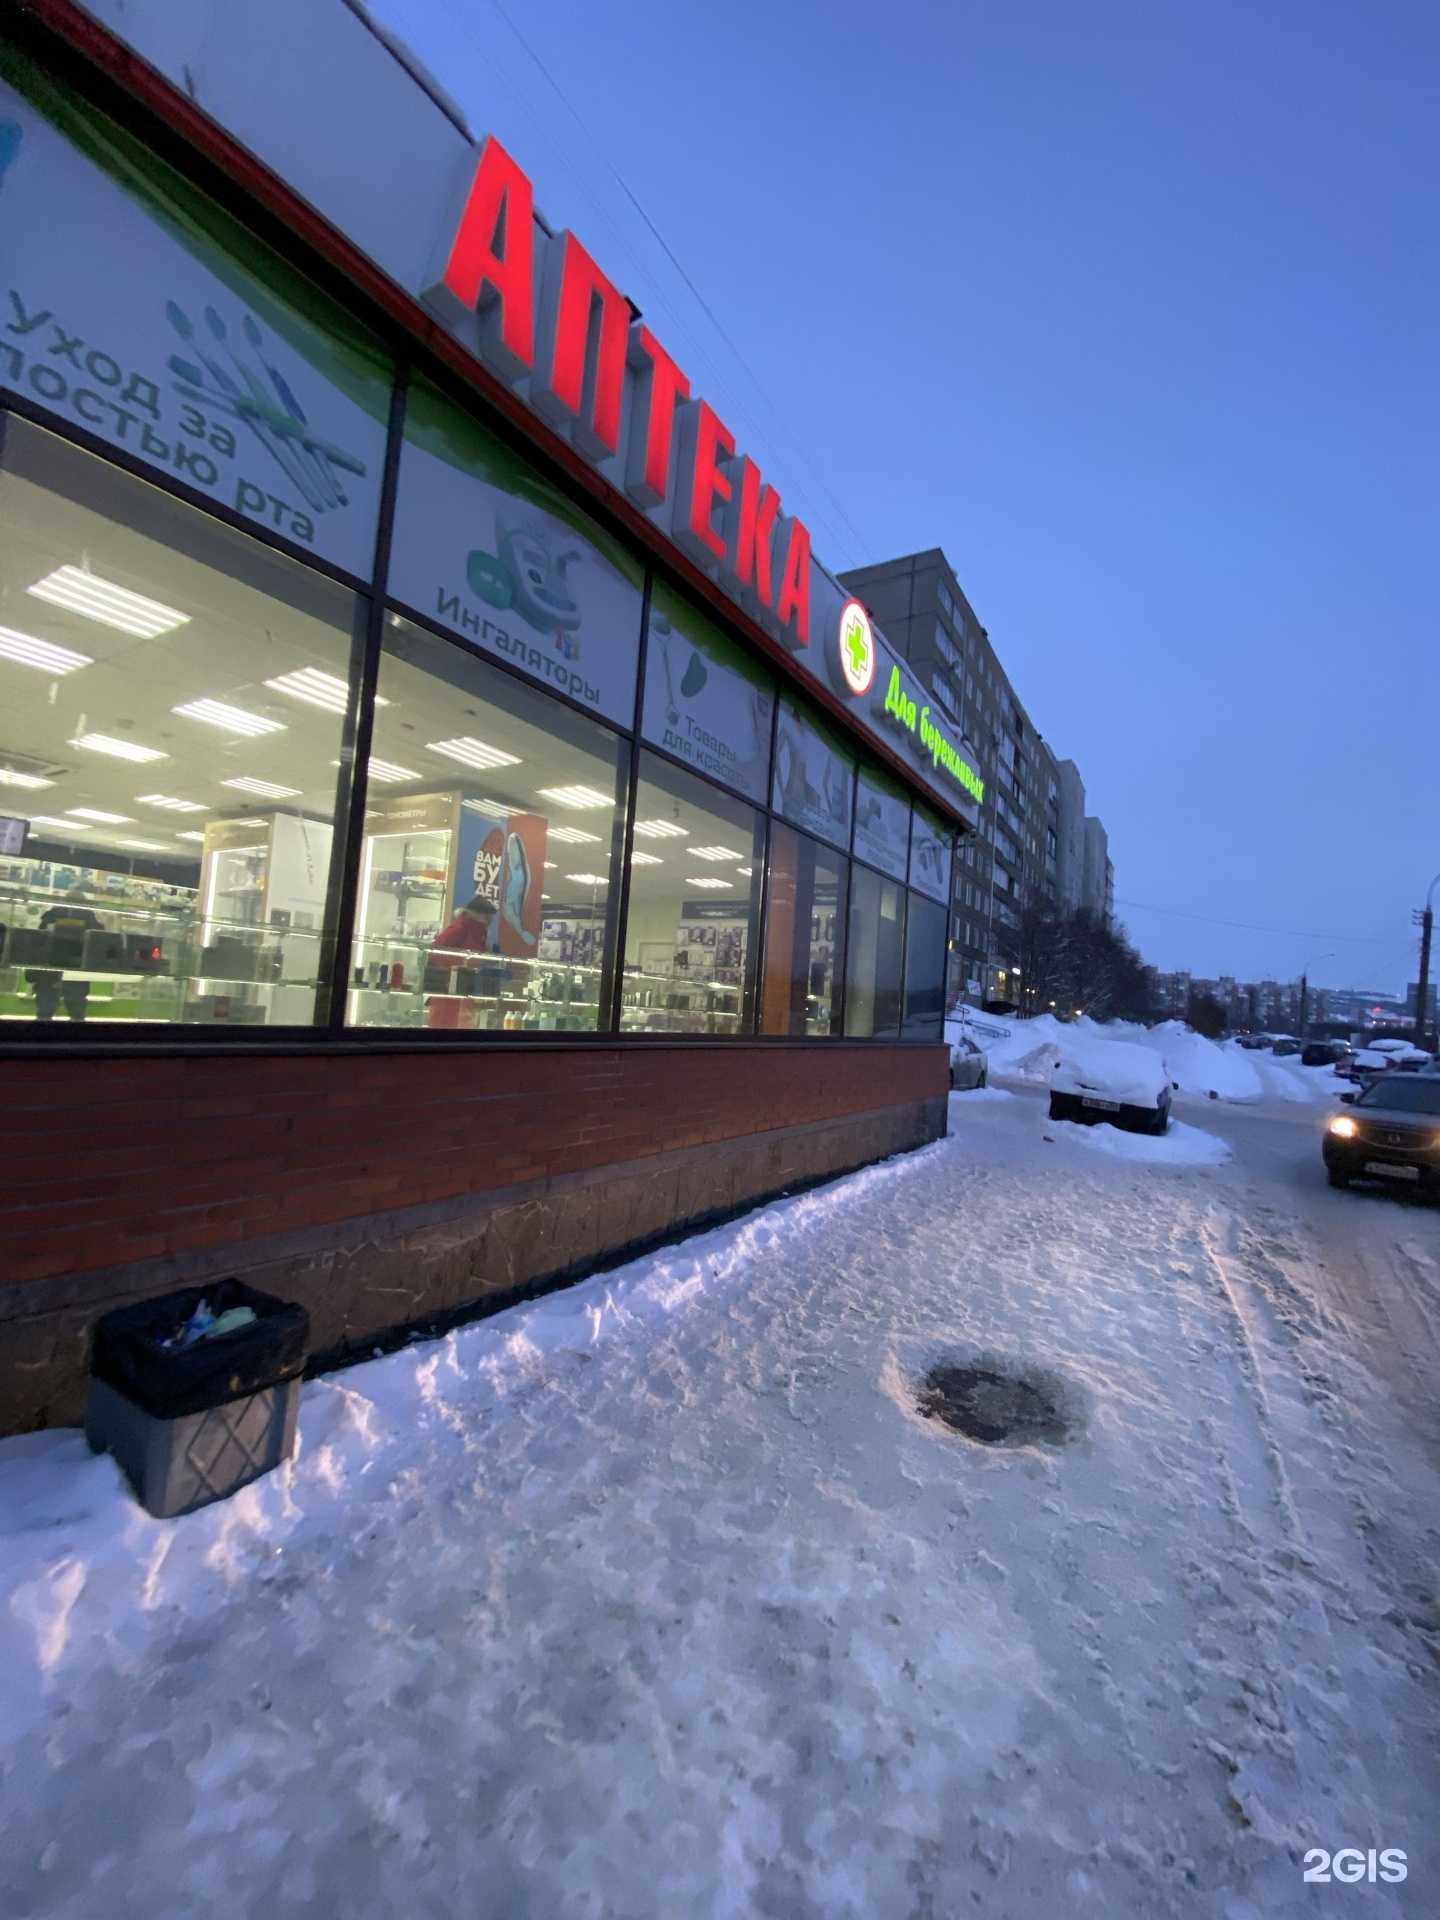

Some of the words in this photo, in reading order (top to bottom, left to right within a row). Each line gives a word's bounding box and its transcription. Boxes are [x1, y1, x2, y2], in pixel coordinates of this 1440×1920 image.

[6, 288, 161, 421] Уход
[178, 403, 237, 460] за
[443, 134, 811, 649] АПТЕКА
[234, 477, 315, 543] рта
[436, 586, 600, 705] Ингаляторы
[662, 728, 693, 760] для
[695, 750, 752, 790] красо
[685, 714, 737, 761] Товары
[885, 663, 917, 734] Для
[919, 706, 985, 805] бережливых
[473, 861, 500, 884] БУ
[474, 882, 500, 899] ДЕТ
[475, 850, 502, 867] ВАМ
